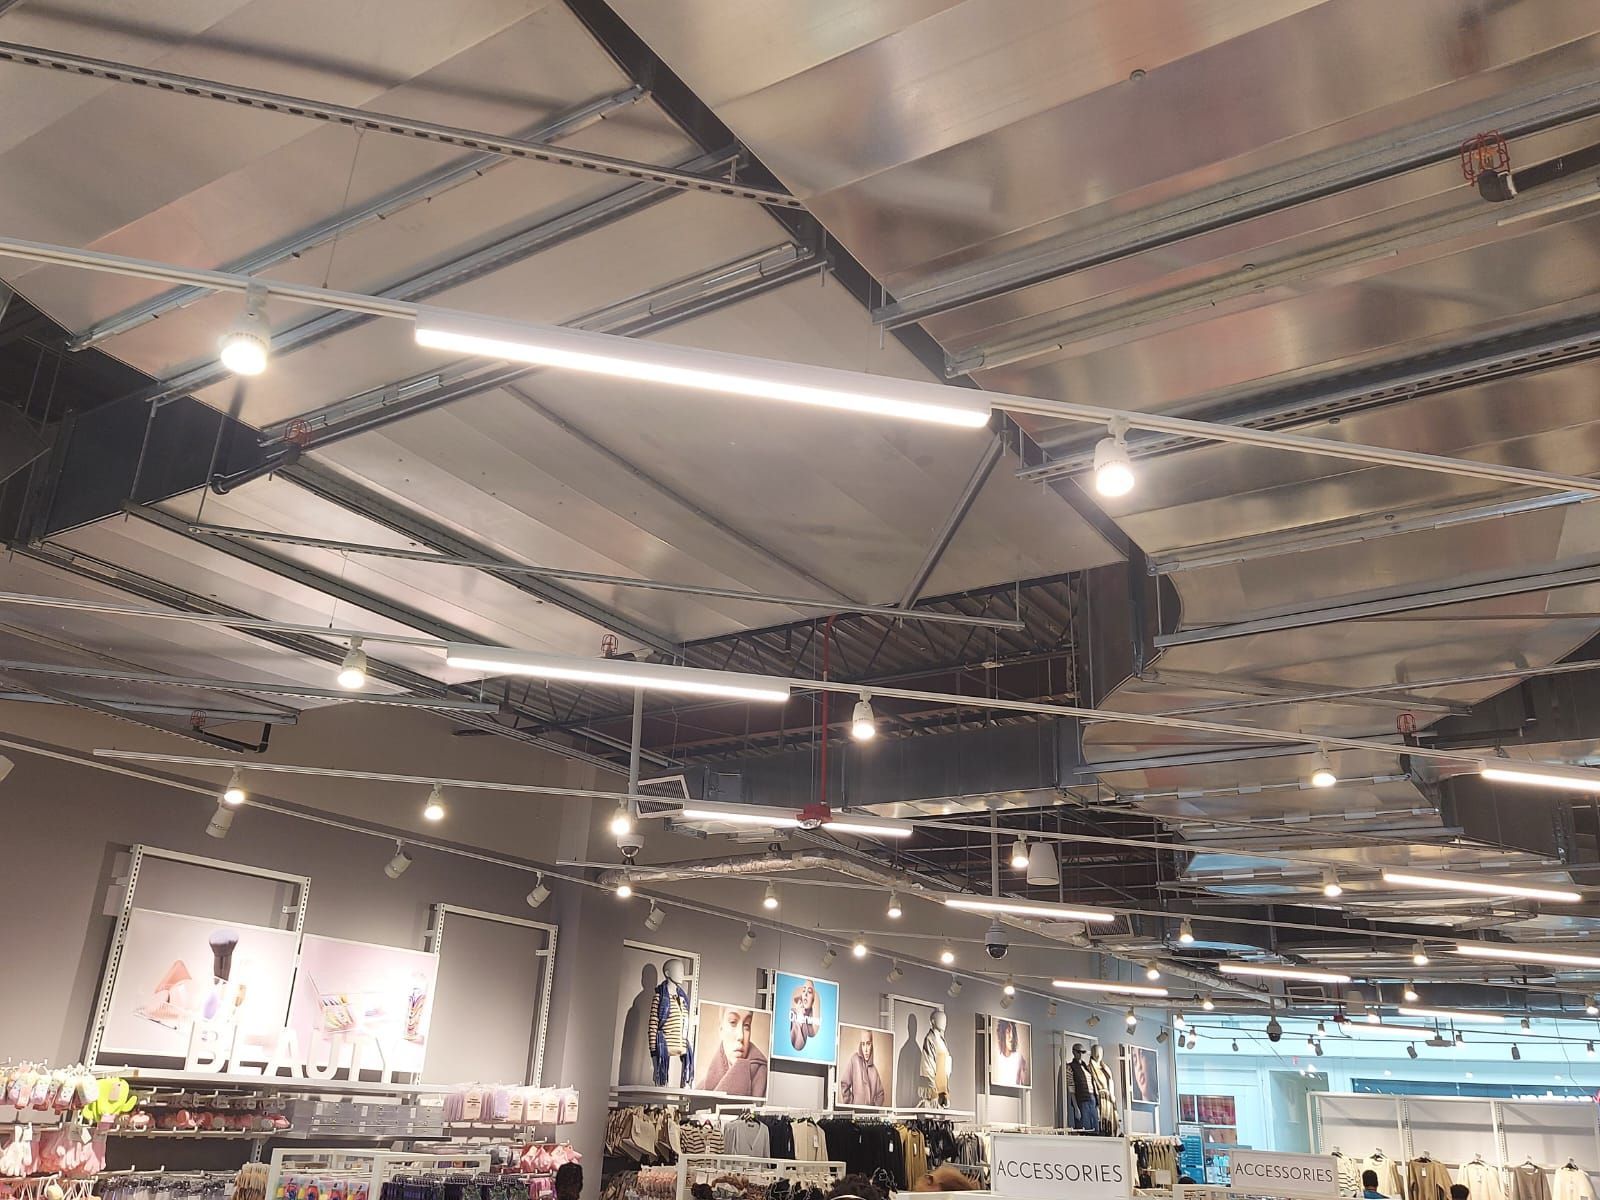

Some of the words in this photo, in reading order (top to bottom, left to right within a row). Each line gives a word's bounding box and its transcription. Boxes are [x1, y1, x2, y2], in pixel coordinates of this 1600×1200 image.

[184, 1020, 404, 1084] BEAUTY
[997, 1160, 1122, 1183] ACCESSORIES
[1235, 1163, 1333, 1183] ACCESSORIES
